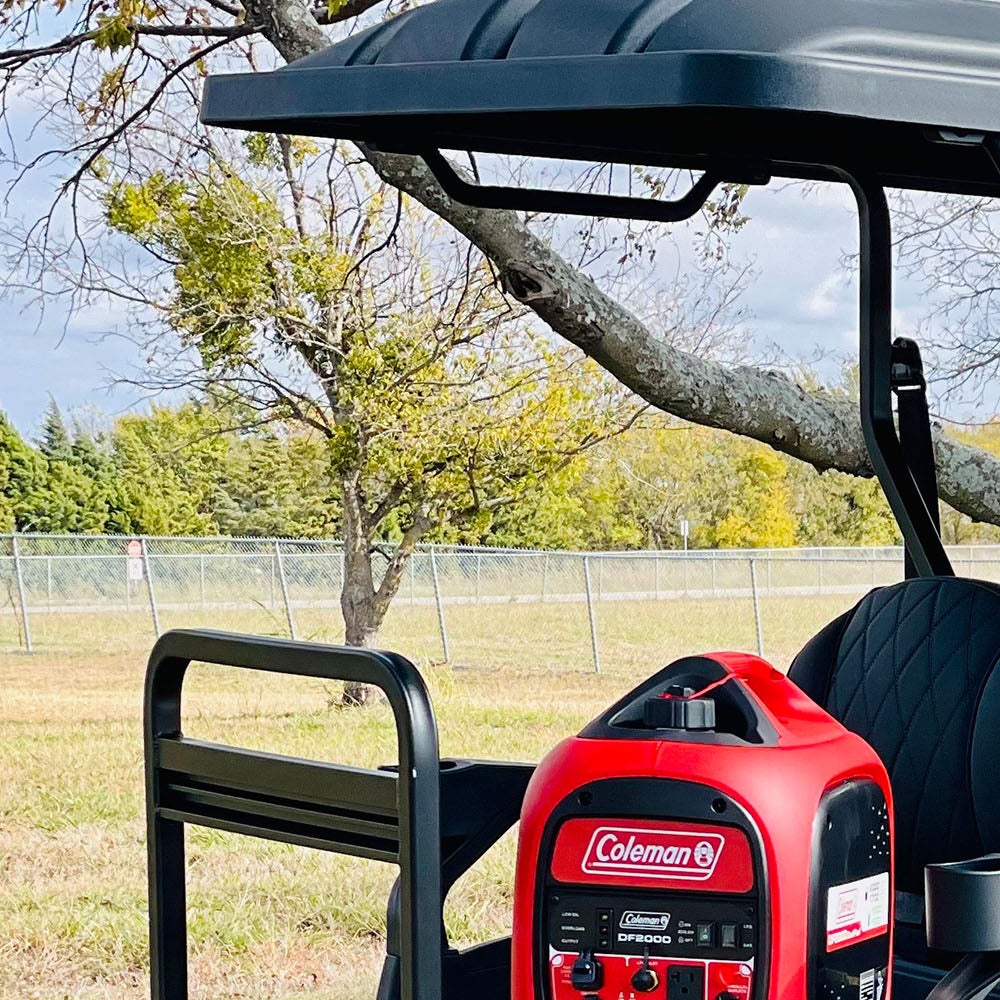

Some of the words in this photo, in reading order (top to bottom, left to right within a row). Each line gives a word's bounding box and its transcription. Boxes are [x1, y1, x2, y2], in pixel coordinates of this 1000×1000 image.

[596, 833, 691, 865] Coleman
[625, 913, 660, 925] Coleman
[617, 933, 672, 944] DF2000
